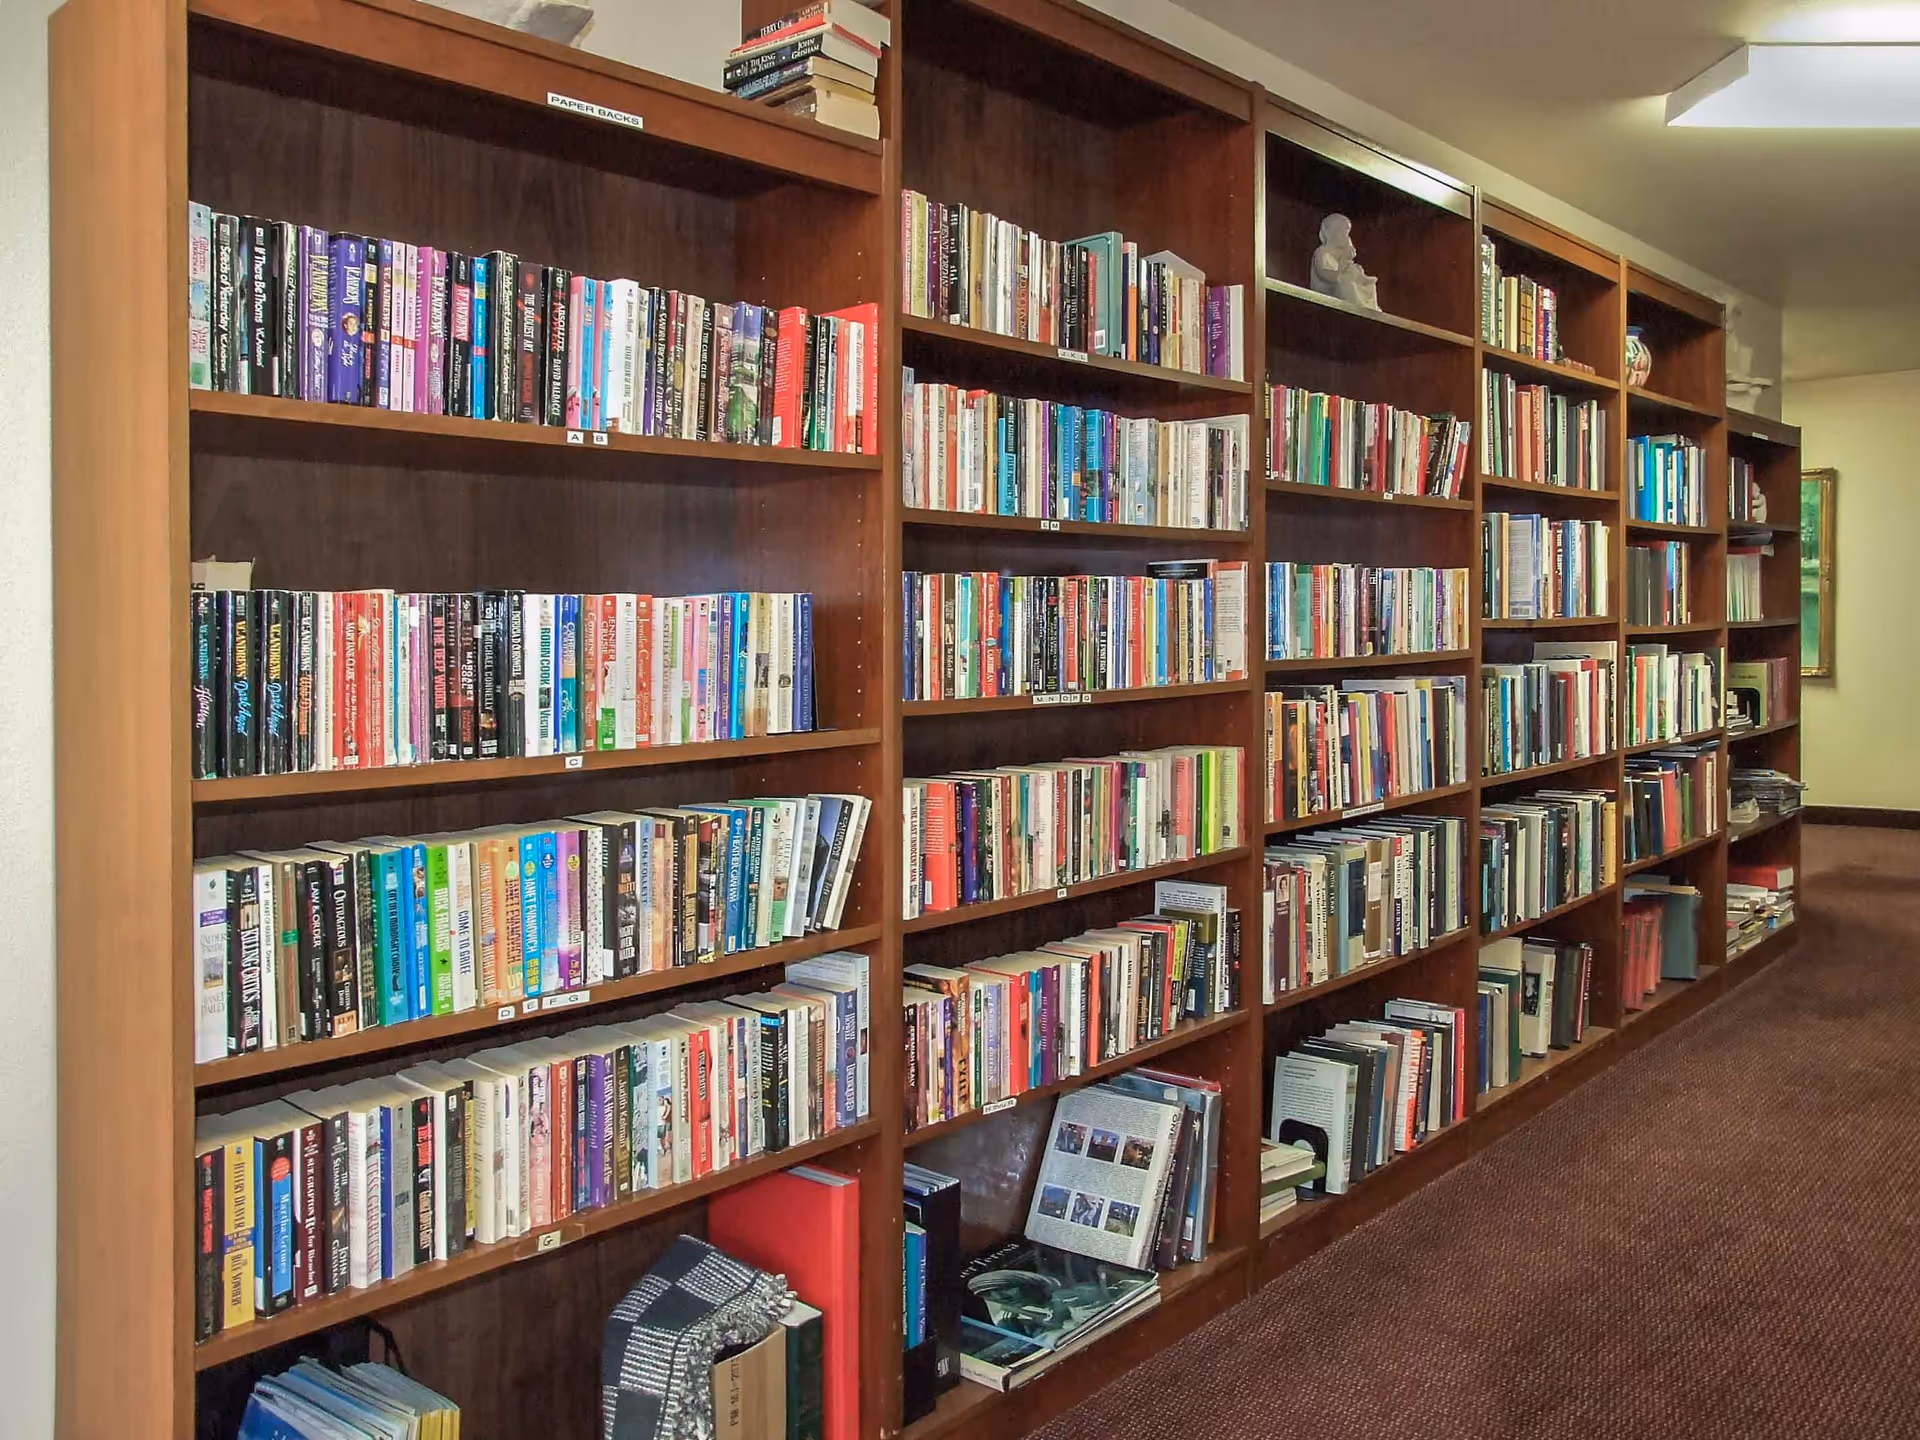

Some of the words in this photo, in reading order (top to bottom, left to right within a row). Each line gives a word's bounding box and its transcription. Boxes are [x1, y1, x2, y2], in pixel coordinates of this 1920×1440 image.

[791, 45, 820, 59] GRISHAM
[797, 38, 815, 51] JOHN
[551, 96, 594, 114] PAPER
[598, 108, 639, 126] BACKS
[220, 245, 232, 273] Seeds
[255, 247, 266, 255] If
[220, 275, 232, 286] of
[255, 255, 266, 280] There
[255, 281, 266, 293] Be
[309, 267, 328, 314] ANDREWS
[524, 294, 534, 305] THE
[218, 286, 233, 331] Yesterday
[286, 287, 297, 332] Yesterday
[382, 281, 391, 327] ANDREWS
[431, 289, 444, 338] ANDREWS
[503, 290, 511, 316] Sweet
[503, 317, 511, 349] Audrina
[524, 306, 534, 337] DEADLIEST
[557, 302, 565, 352] ABSOLUTE
[657, 313, 667, 341] SANDRA
[524, 338, 534, 352] ART
[675, 322, 685, 360] Jennifer
[552, 358, 561, 380] DAVID
[656, 342, 666, 374] BROWN
[700, 362, 708, 379] CLUB
[552, 380, 561, 416] BALDACCI
[655, 386, 665, 421] CHARADE
[673, 390, 682, 418] Blake
[571, 433, 579, 441] A
[595, 434, 603, 442] B
[435, 628, 446, 646] THE
[512, 610, 521, 638] PATRICIA
[600, 621, 609, 654] CRUSIE
[607, 616, 616, 660] JENNIFER
[235, 635, 247, 678] ANDREWS
[301, 627, 311, 671] ANDREWS
[484, 634, 494, 670] MICHAEL
[540, 627, 551, 658] ROBIN
[198, 638, 208, 679] ANDREWS
[269, 637, 281, 680] ANDREWS
[435, 648, 446, 672] DEEP
[512, 644, 521, 677] CORNWELL
[540, 659, 551, 686] COOK
[234, 680, 252, 707] Dark
[267, 682, 284, 708] Dark
[435, 674, 446, 709] WOODS
[484, 670, 495, 711] CONNELLY
[193, 686, 212, 728] Heaven
[235, 707, 252, 737] Angel
[267, 708, 284, 738] Angel
[540, 709, 551, 739] VECTOR
[569, 759, 578, 767] C
[641, 837, 649, 859] KEN
[732, 835, 742, 869] HEATHER
[310, 881, 321, 905] LAW
[505, 878, 520, 907] JANET
[525, 877, 537, 903] JANET
[641, 859, 649, 905] FOLLETT
[730, 869, 740, 903] GRAHAM
[311, 905, 320, 914] &
[434, 887, 450, 912] DICK
[311, 914, 321, 947] ORDER
[333, 889, 347, 948] OUTRAGEOUS
[434, 912, 450, 952] FRANCIS
[458, 909, 469, 935] COME
[525, 904, 538, 955] EVANOVICH
[241, 927, 260, 967] KILLING
[389, 917, 399, 954] MIDNIGHT
[459, 937, 470, 949] TO
[505, 908, 521, 964] EVANOVICH
[460, 950, 471, 976] GRIEF
[241, 967, 260, 1003] CRITICS
[500, 1009, 510, 1018] D
[527, 1002, 535, 1010] E
[604, 1074, 614, 1102] LINDA
[619, 1079, 628, 1109] Judith
[958, 1058, 967, 1105] EXILE
[604, 1102, 614, 1141] HOWARD
[619, 1111, 628, 1148] Kelman
[332, 1157, 341, 1207] SUMMONS
[341, 1171, 349, 1186] THE
[366, 1161, 380, 1192] TESS
[306, 1176, 314, 1216] GRAFTON
[234, 1195, 246, 1230] DEAVER
[280, 1194, 290, 1232] Martha
[304, 1216, 315, 1228] R
[366, 1193, 380, 1276] GERRITSEN
[544, 1236, 553, 1246] G
[280, 1235, 290, 1275] Grimes
[332, 1239, 340, 1288] GRISHAM
[338, 1246, 349, 1275] JOHN
